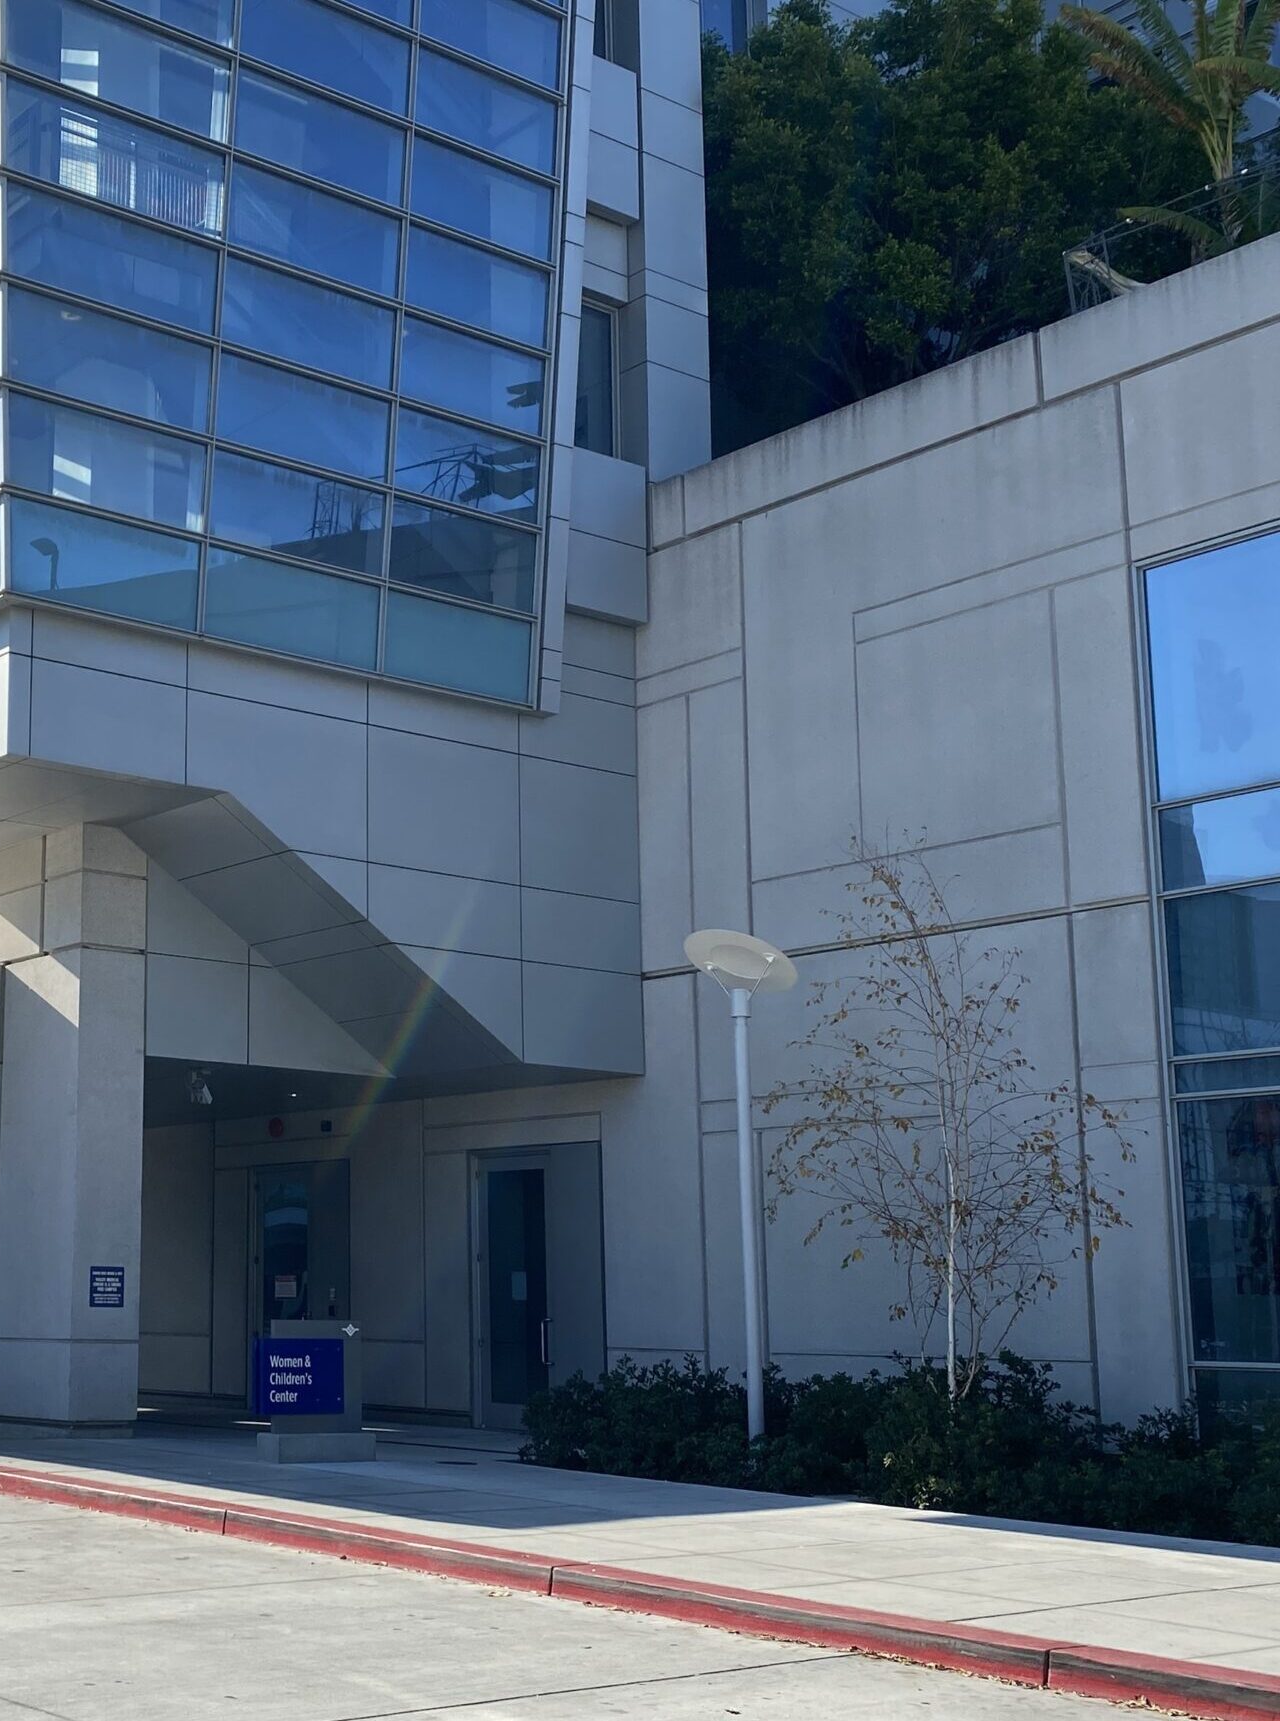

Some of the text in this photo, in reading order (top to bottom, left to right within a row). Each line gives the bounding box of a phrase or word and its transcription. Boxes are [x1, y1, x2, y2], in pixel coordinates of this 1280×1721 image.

[269, 1355, 311, 1368] Women &
[269, 1372, 312, 1385] Children's
[269, 1390, 298, 1403] Center
